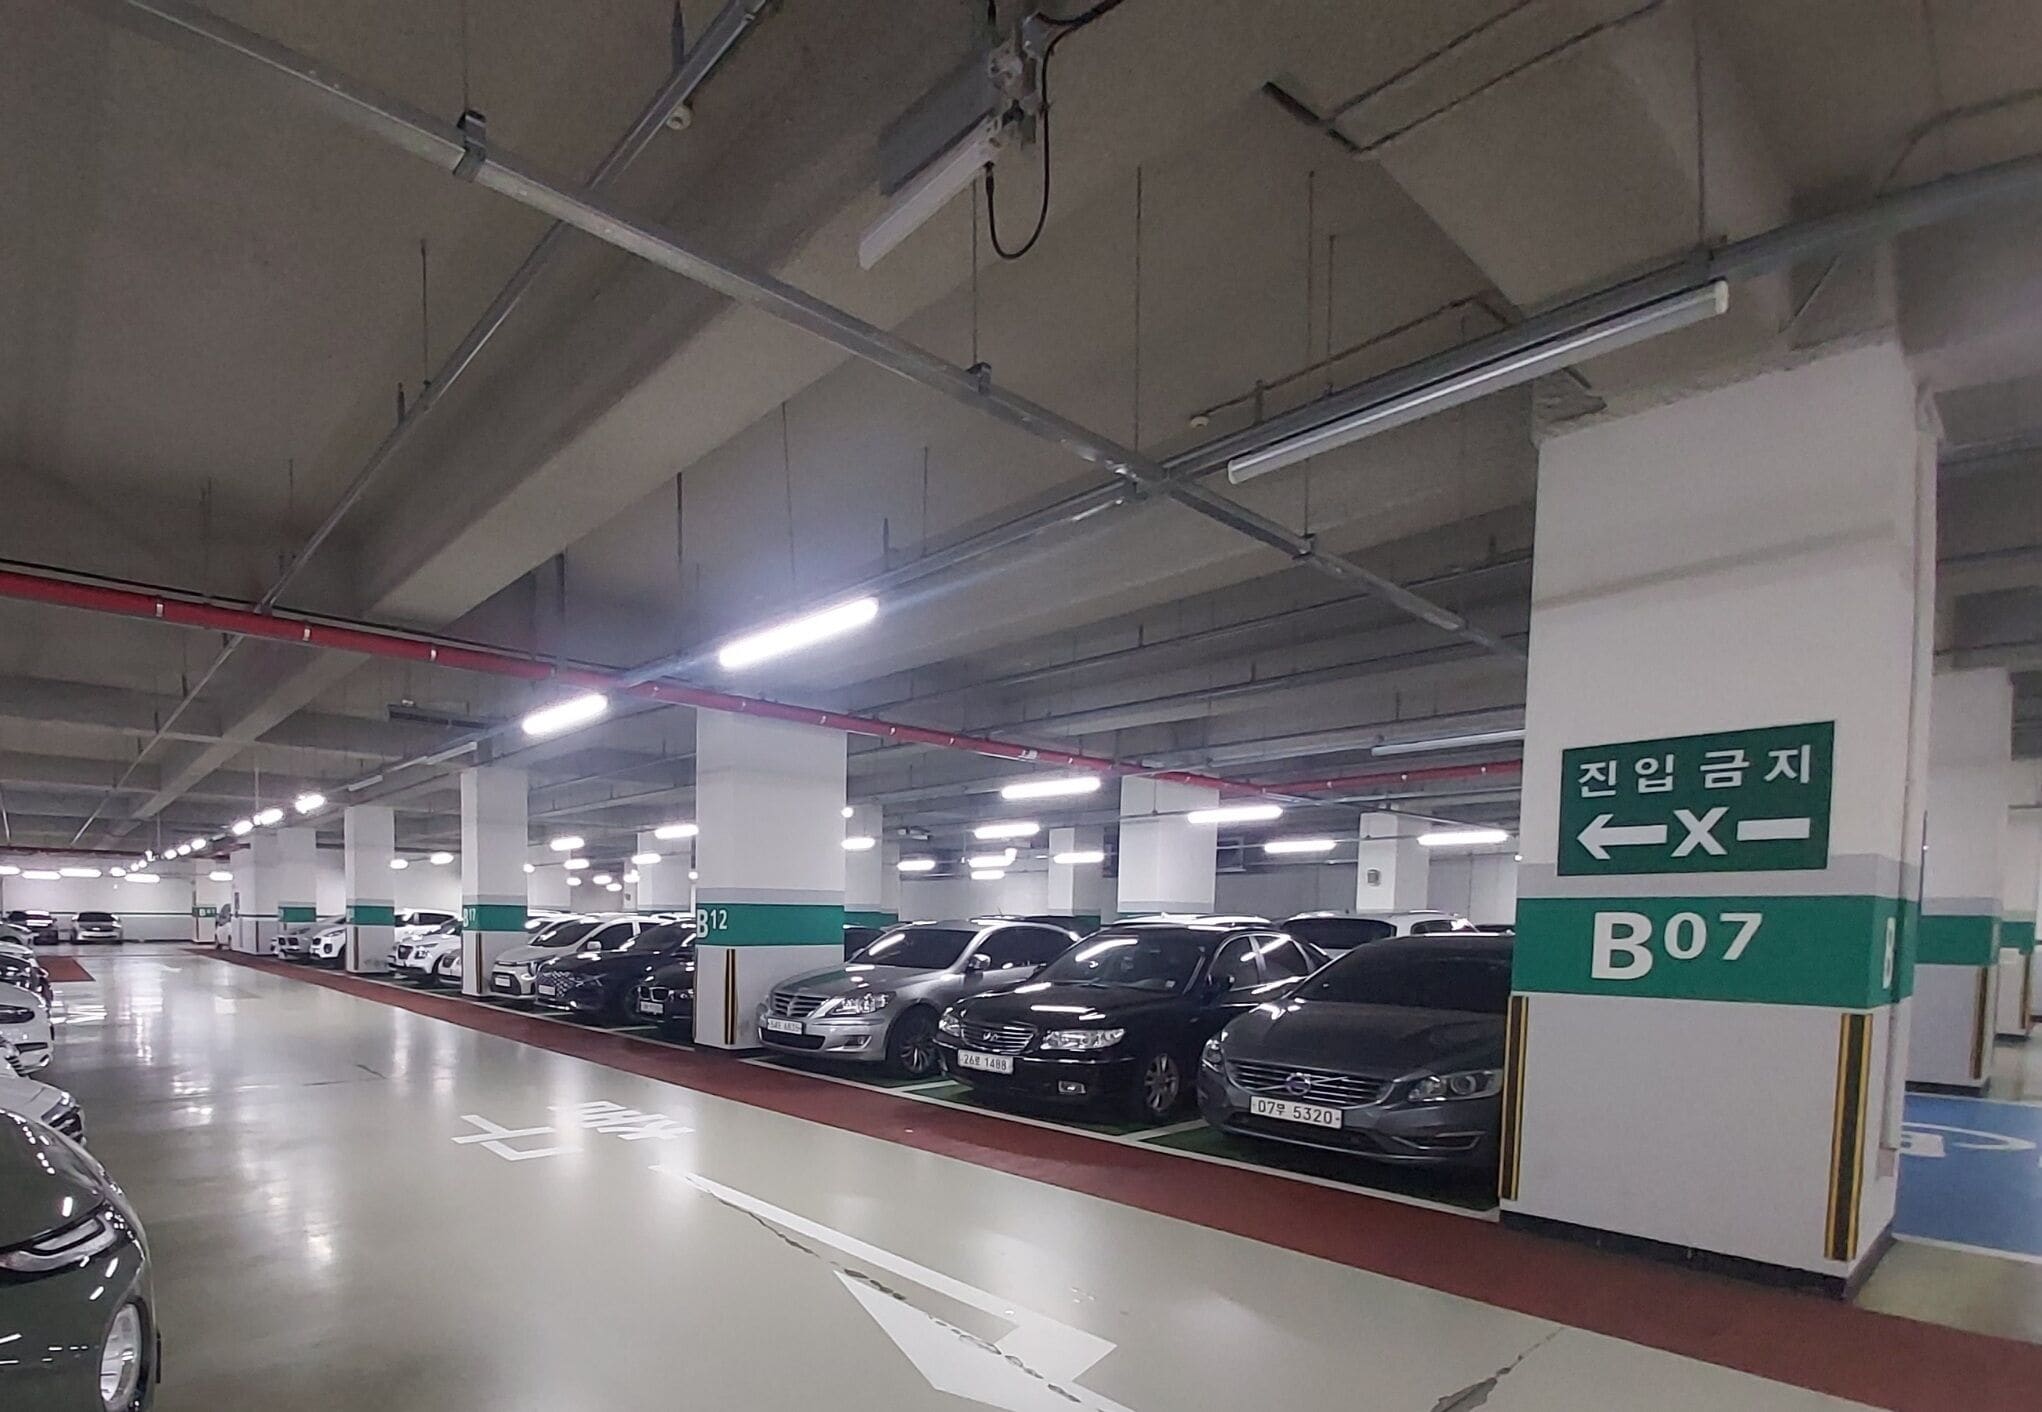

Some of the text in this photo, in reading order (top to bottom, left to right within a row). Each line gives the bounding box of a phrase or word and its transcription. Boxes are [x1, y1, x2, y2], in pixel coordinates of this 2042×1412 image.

[1577, 744, 1811, 799] 진입 금지
[697, 908, 728, 938] B12
[1589, 911, 1763, 981] B07
[984, 1057, 1007, 1071] 1488
[1259, 1100, 1332, 1123] 07무 5320
